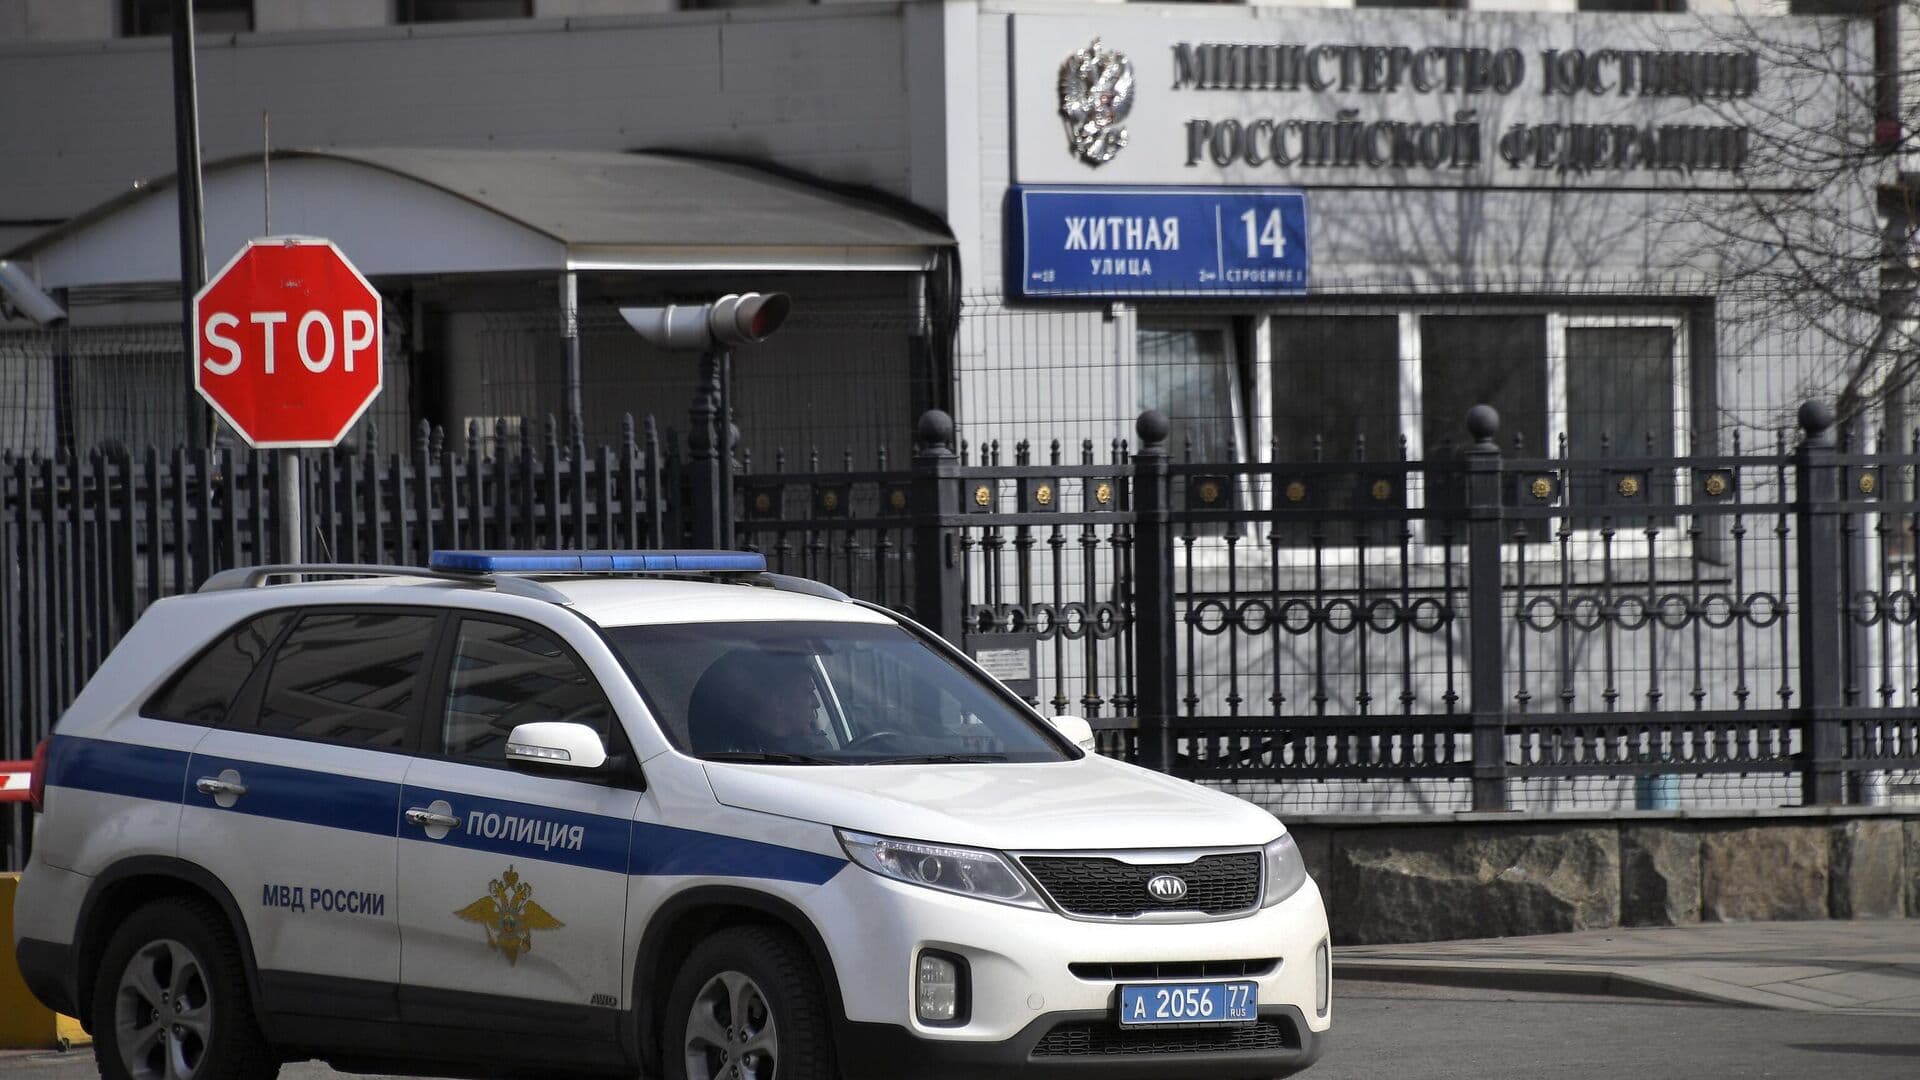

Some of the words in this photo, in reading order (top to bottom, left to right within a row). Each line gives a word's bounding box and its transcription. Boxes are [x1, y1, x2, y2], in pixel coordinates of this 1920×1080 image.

[1171, 43, 1525, 95] МИНИСТЕРСТВО
[1184, 108, 1480, 169] РОССИЙСКОЙ
[1500, 122, 1749, 175] ФЕДЕРАЦИИ
[1064, 216, 1180, 250] ЖИТНАЯ
[1241, 208, 1287, 258] 14
[1091, 258, 1152, 276] УЛИЦА
[1226, 269, 1293, 282] СТРОЕНИЕ
[203, 310, 374, 376] STOP
[466, 811, 585, 851] ПОЛИЦИЯ
[262, 884, 305, 912] МВД
[310, 888, 384, 916] РОССИИ
[1152, 879, 1183, 895] KIA
[1156, 988, 1213, 1018] 2056
[1228, 985, 1249, 1008] 77
[1230, 1007, 1247, 1017] RUS
